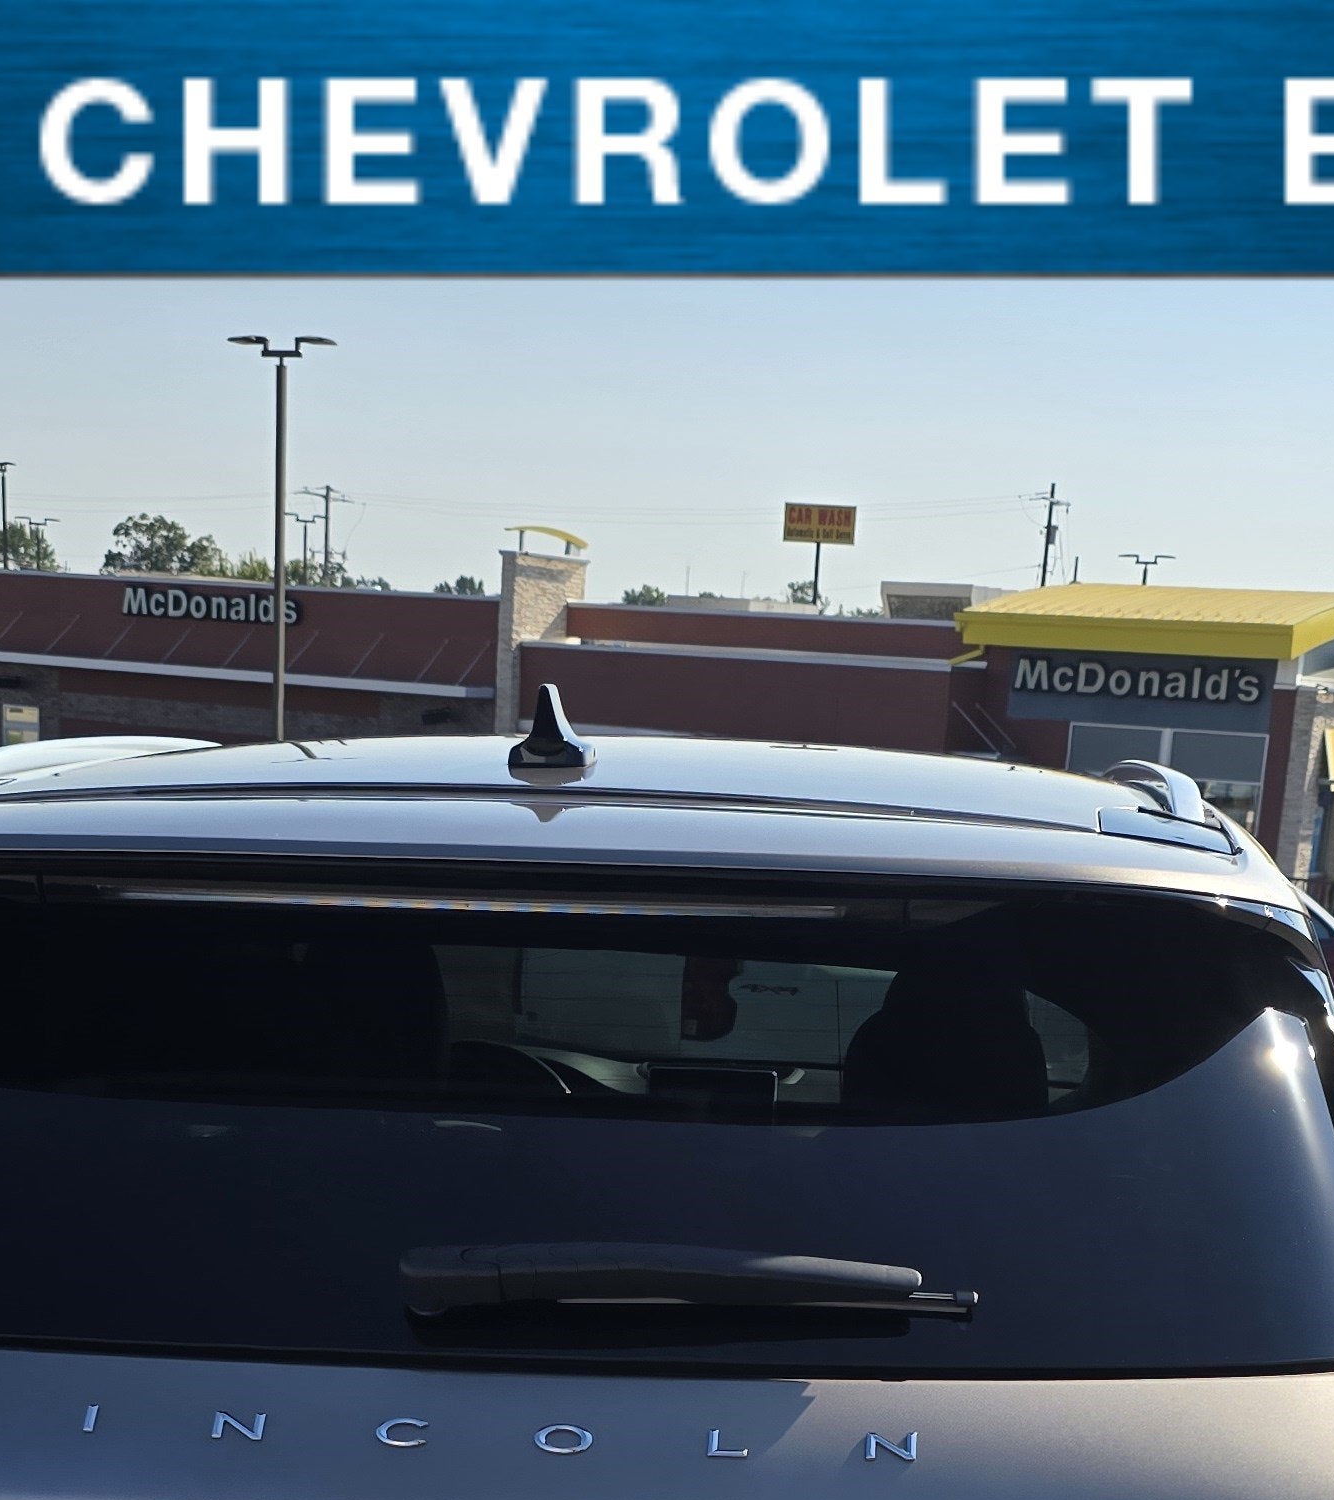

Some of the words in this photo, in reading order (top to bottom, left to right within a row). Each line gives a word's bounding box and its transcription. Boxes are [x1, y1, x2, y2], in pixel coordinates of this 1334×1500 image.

[788, 507, 812, 525] CAR
[818, 508, 852, 528] WASH
[122, 587, 298, 624] McDonalds
[1014, 657, 1260, 702] McDonald's
